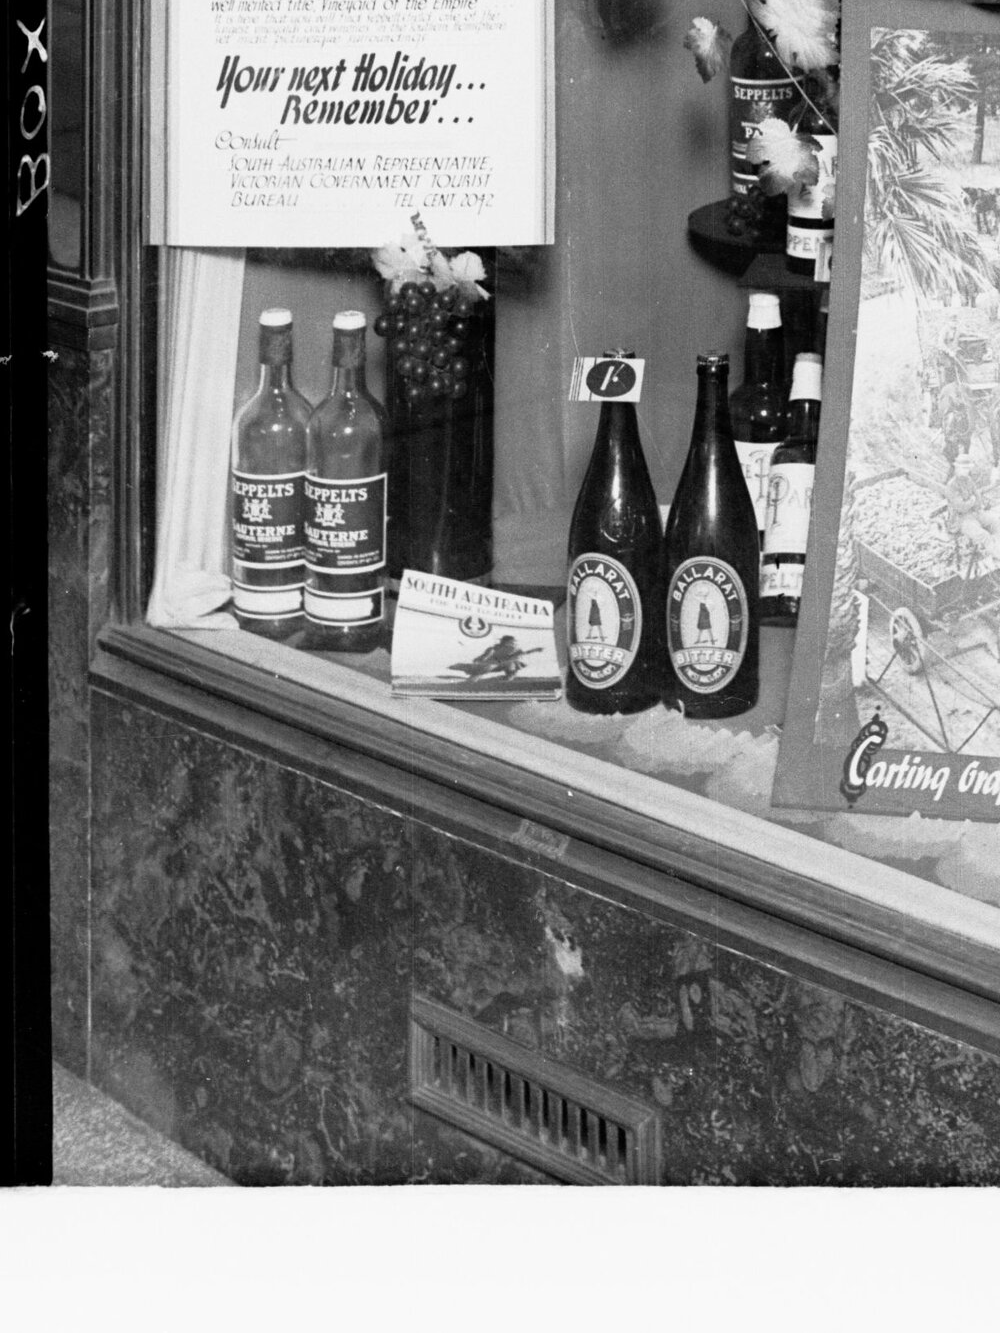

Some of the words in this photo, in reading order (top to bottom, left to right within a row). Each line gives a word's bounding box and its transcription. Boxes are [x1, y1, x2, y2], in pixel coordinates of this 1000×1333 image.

[215, 55, 286, 109] Your
[288, 58, 347, 96] next
[733, 86, 793, 101] SEPPELTS
[214, 129, 298, 151] Consult
[227, 153, 273, 171] SOUTH
[277, 154, 366, 171] AUSTRALIAN
[230, 173, 304, 190] VICTORIAN
[309, 172, 422, 190] GOVERNMENT
[430, 173, 492, 189] TOURIST
[230, 190, 300, 208] BUREAU
[569, 562, 631, 601] BALLARAT
[672, 566, 739, 603] BALLARAT
[405, 576, 458, 600] SOUTH
[460, 589, 550, 618] AUSTRALIA
[571, 645, 626, 663] BITTER
[675, 649, 735, 665] BITTER
[848, 734, 951, 802] Carting
